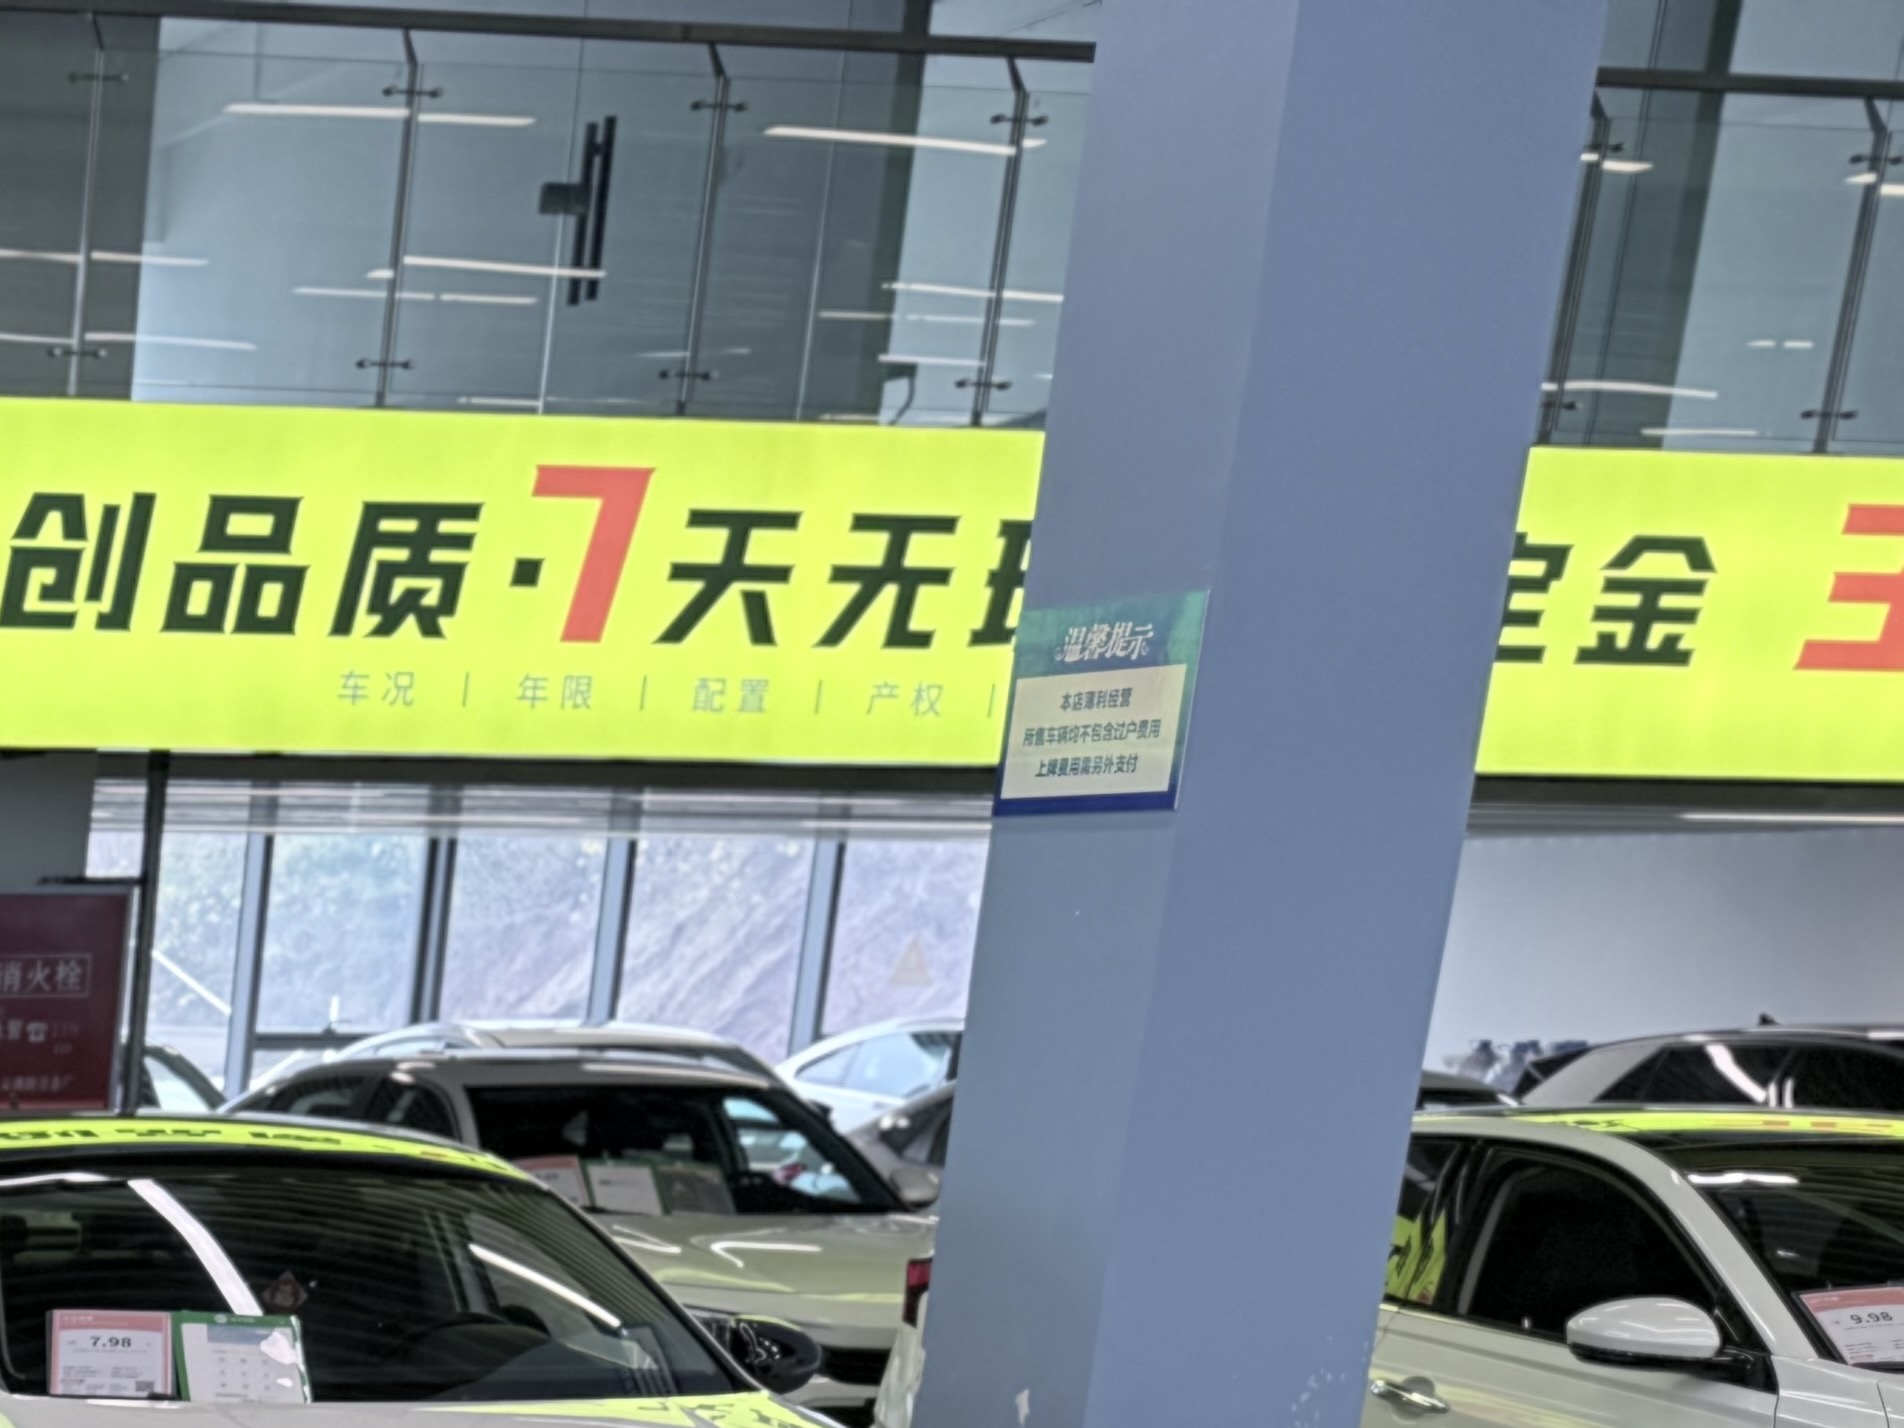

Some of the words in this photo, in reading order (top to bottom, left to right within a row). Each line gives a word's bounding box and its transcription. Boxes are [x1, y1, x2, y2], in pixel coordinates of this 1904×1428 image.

[1062, 621, 1154, 662] 温馨提示
[337, 670, 414, 707] 车况
[516, 673, 594, 710] 年限
[692, 676, 770, 714] 配置
[866, 681, 943, 717] 产权
[1850, 1312, 1893, 1325] 9.98
[90, 1335, 132, 1348] 7.98
